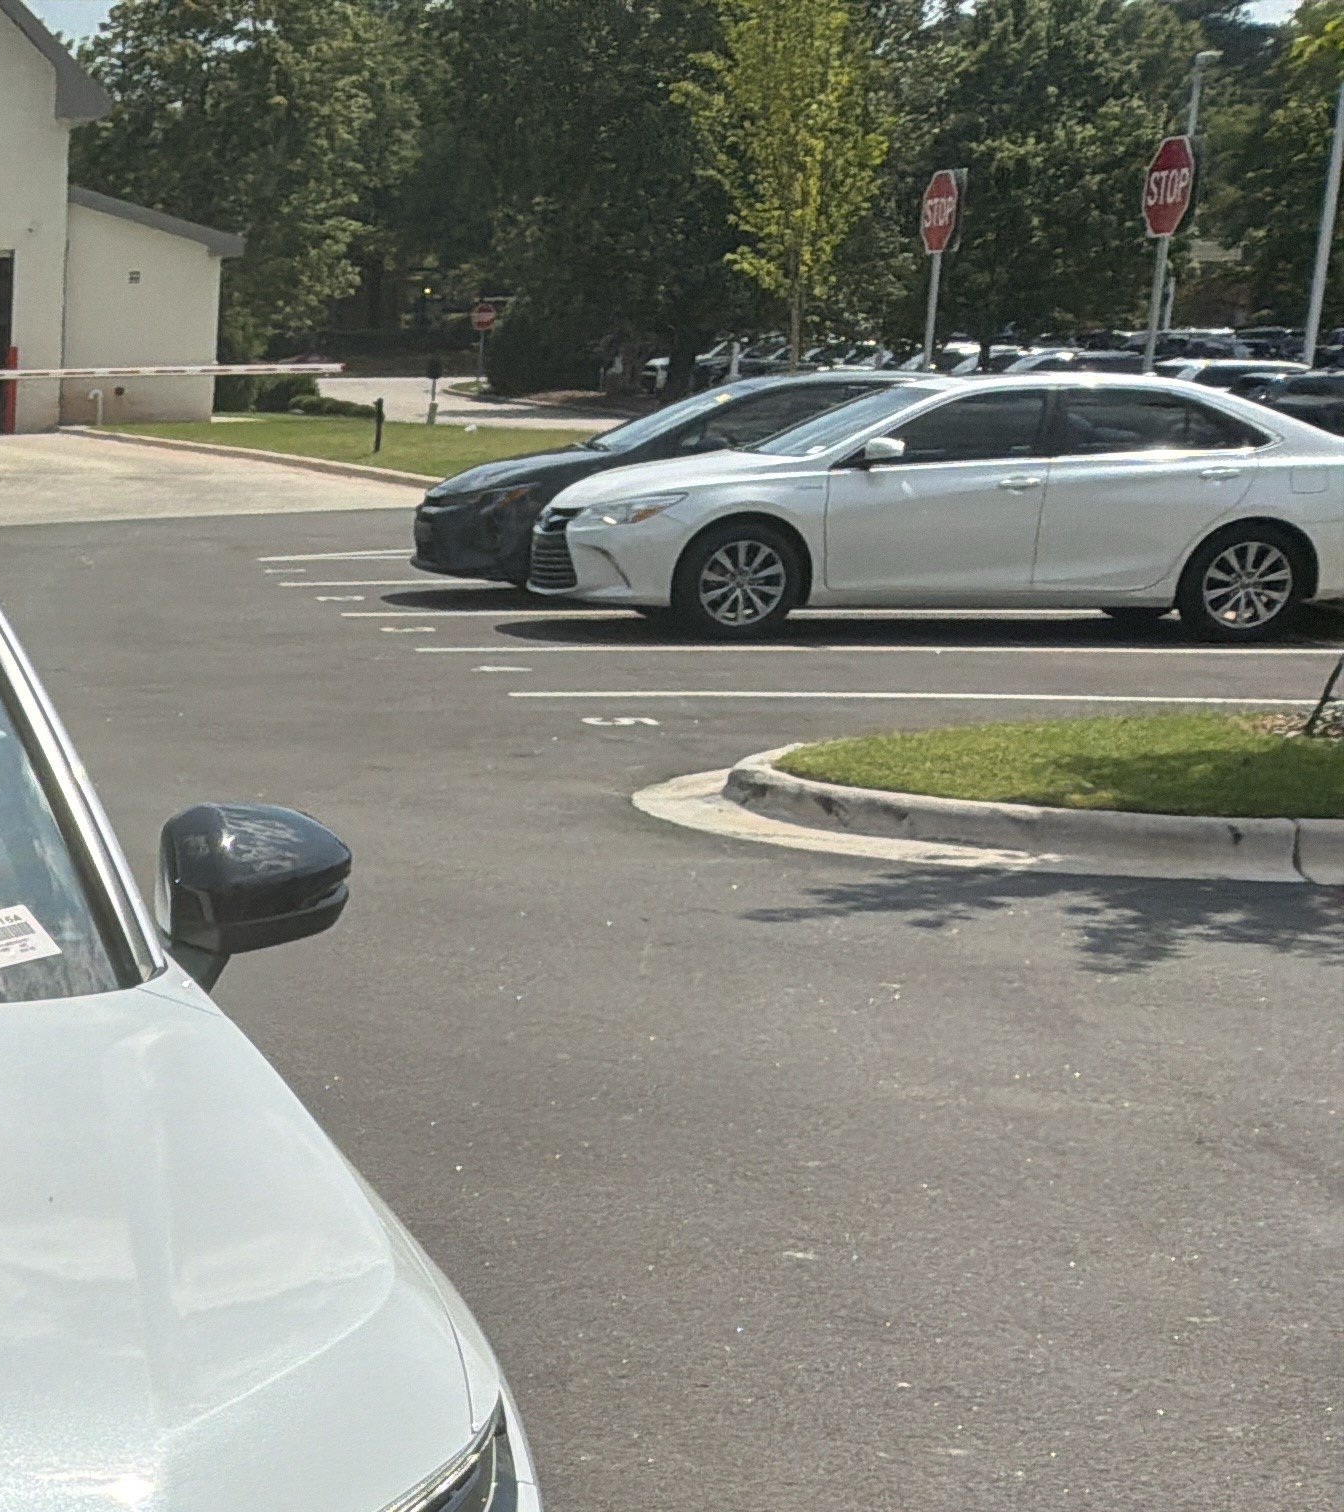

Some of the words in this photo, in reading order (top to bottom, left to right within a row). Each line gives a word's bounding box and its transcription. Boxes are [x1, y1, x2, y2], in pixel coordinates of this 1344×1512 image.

[1147, 167, 1189, 206] STOP
[924, 196, 955, 227] STOP
[581, 716, 660, 726] 5
